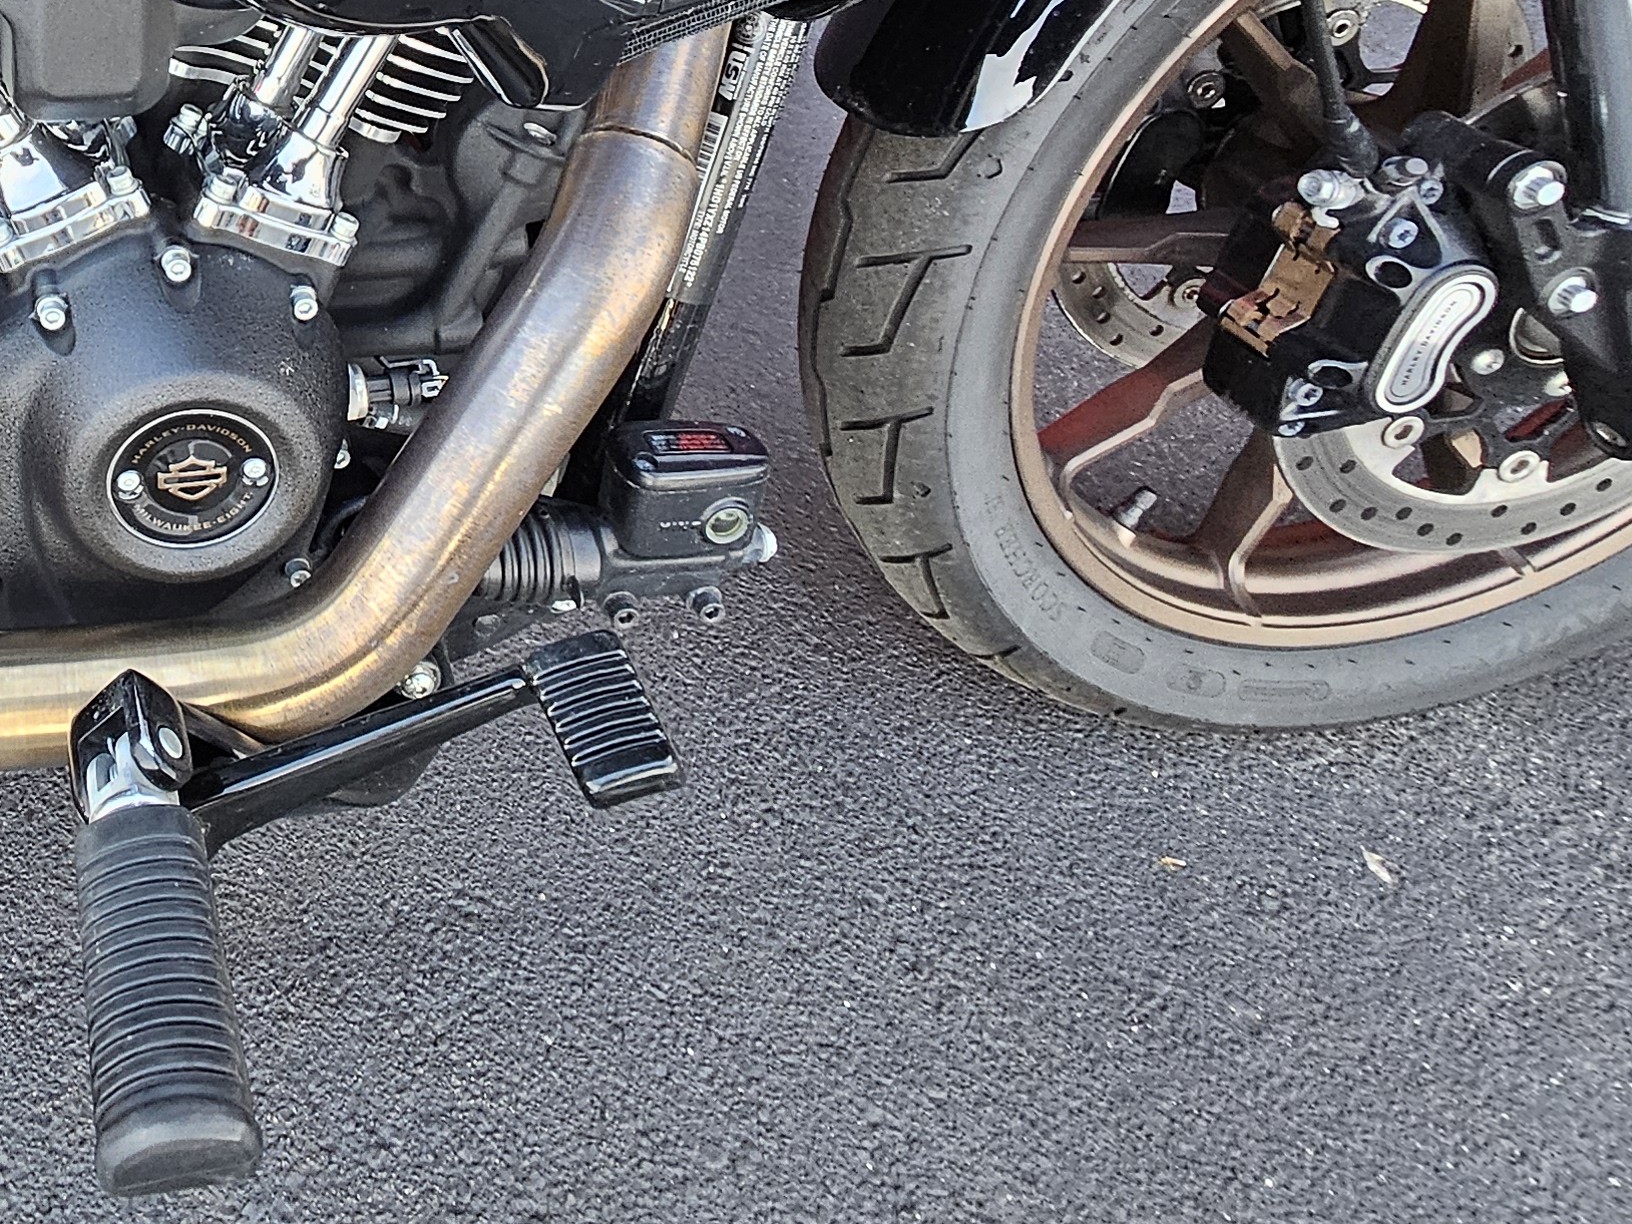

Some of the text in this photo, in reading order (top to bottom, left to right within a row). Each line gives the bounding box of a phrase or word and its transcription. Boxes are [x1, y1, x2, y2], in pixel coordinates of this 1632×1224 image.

[758, 50, 768, 62] OF
[761, 32, 774, 51] DATE
[773, 37, 790, 67] VEHICLE
[762, 48, 778, 76] SAFETY
[740, 61, 764, 112] MANUFACTURE
[748, 75, 768, 116] STANDARDS
[760, 66, 779, 105] CONFORMS
[756, 106, 767, 116] TO
[737, 124, 752, 153] EFFECT
[738, 128, 758, 169] APPLICABLE
[724, 179, 741, 209] FEDERAL
[716, 209, 730, 234] MOTOR
[678, 229, 699, 273] MOTORCYCLE
